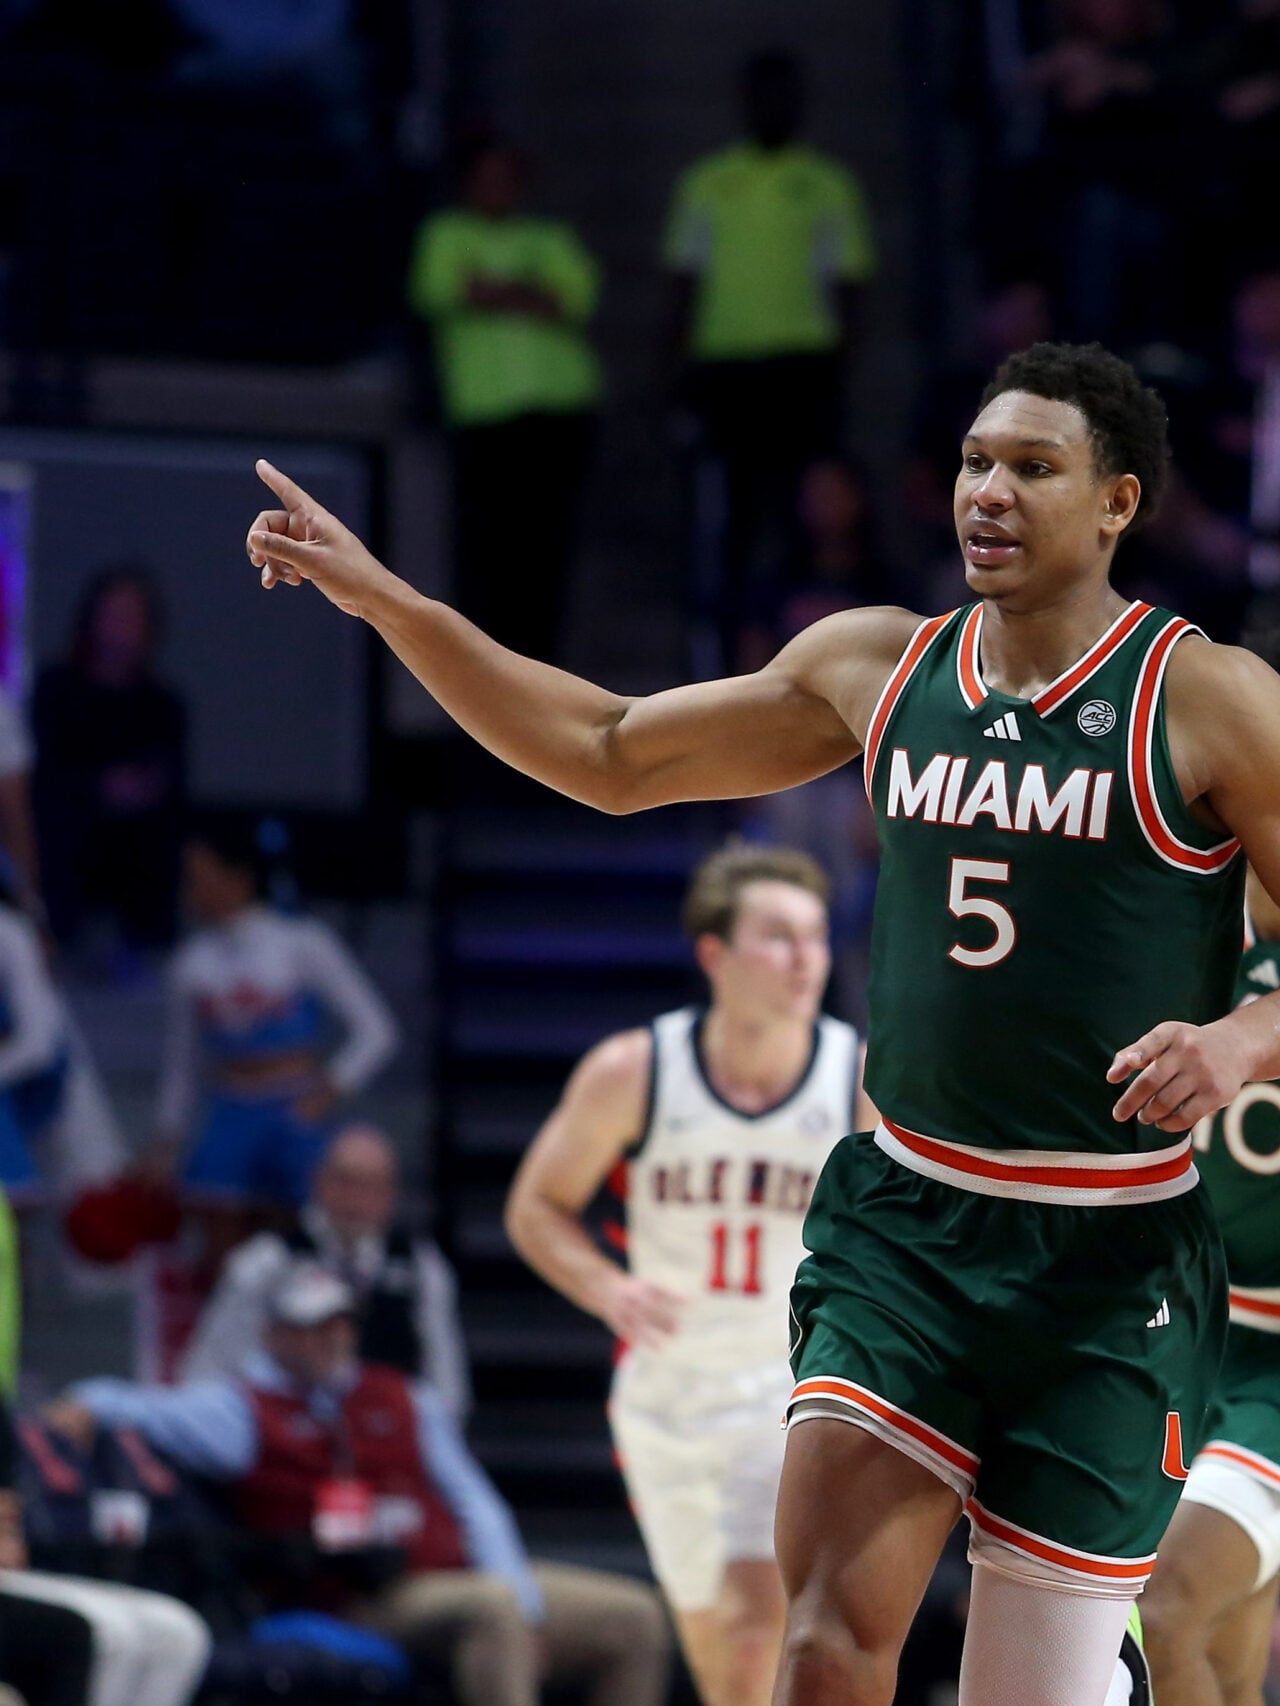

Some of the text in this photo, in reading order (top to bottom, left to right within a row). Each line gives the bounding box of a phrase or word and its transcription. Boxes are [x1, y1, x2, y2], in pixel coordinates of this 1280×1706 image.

[1083, 711, 1114, 723] ACC
[886, 747, 1115, 841] MIAMI
[947, 856, 1018, 970] 5
[709, 1220, 762, 1295] 11
